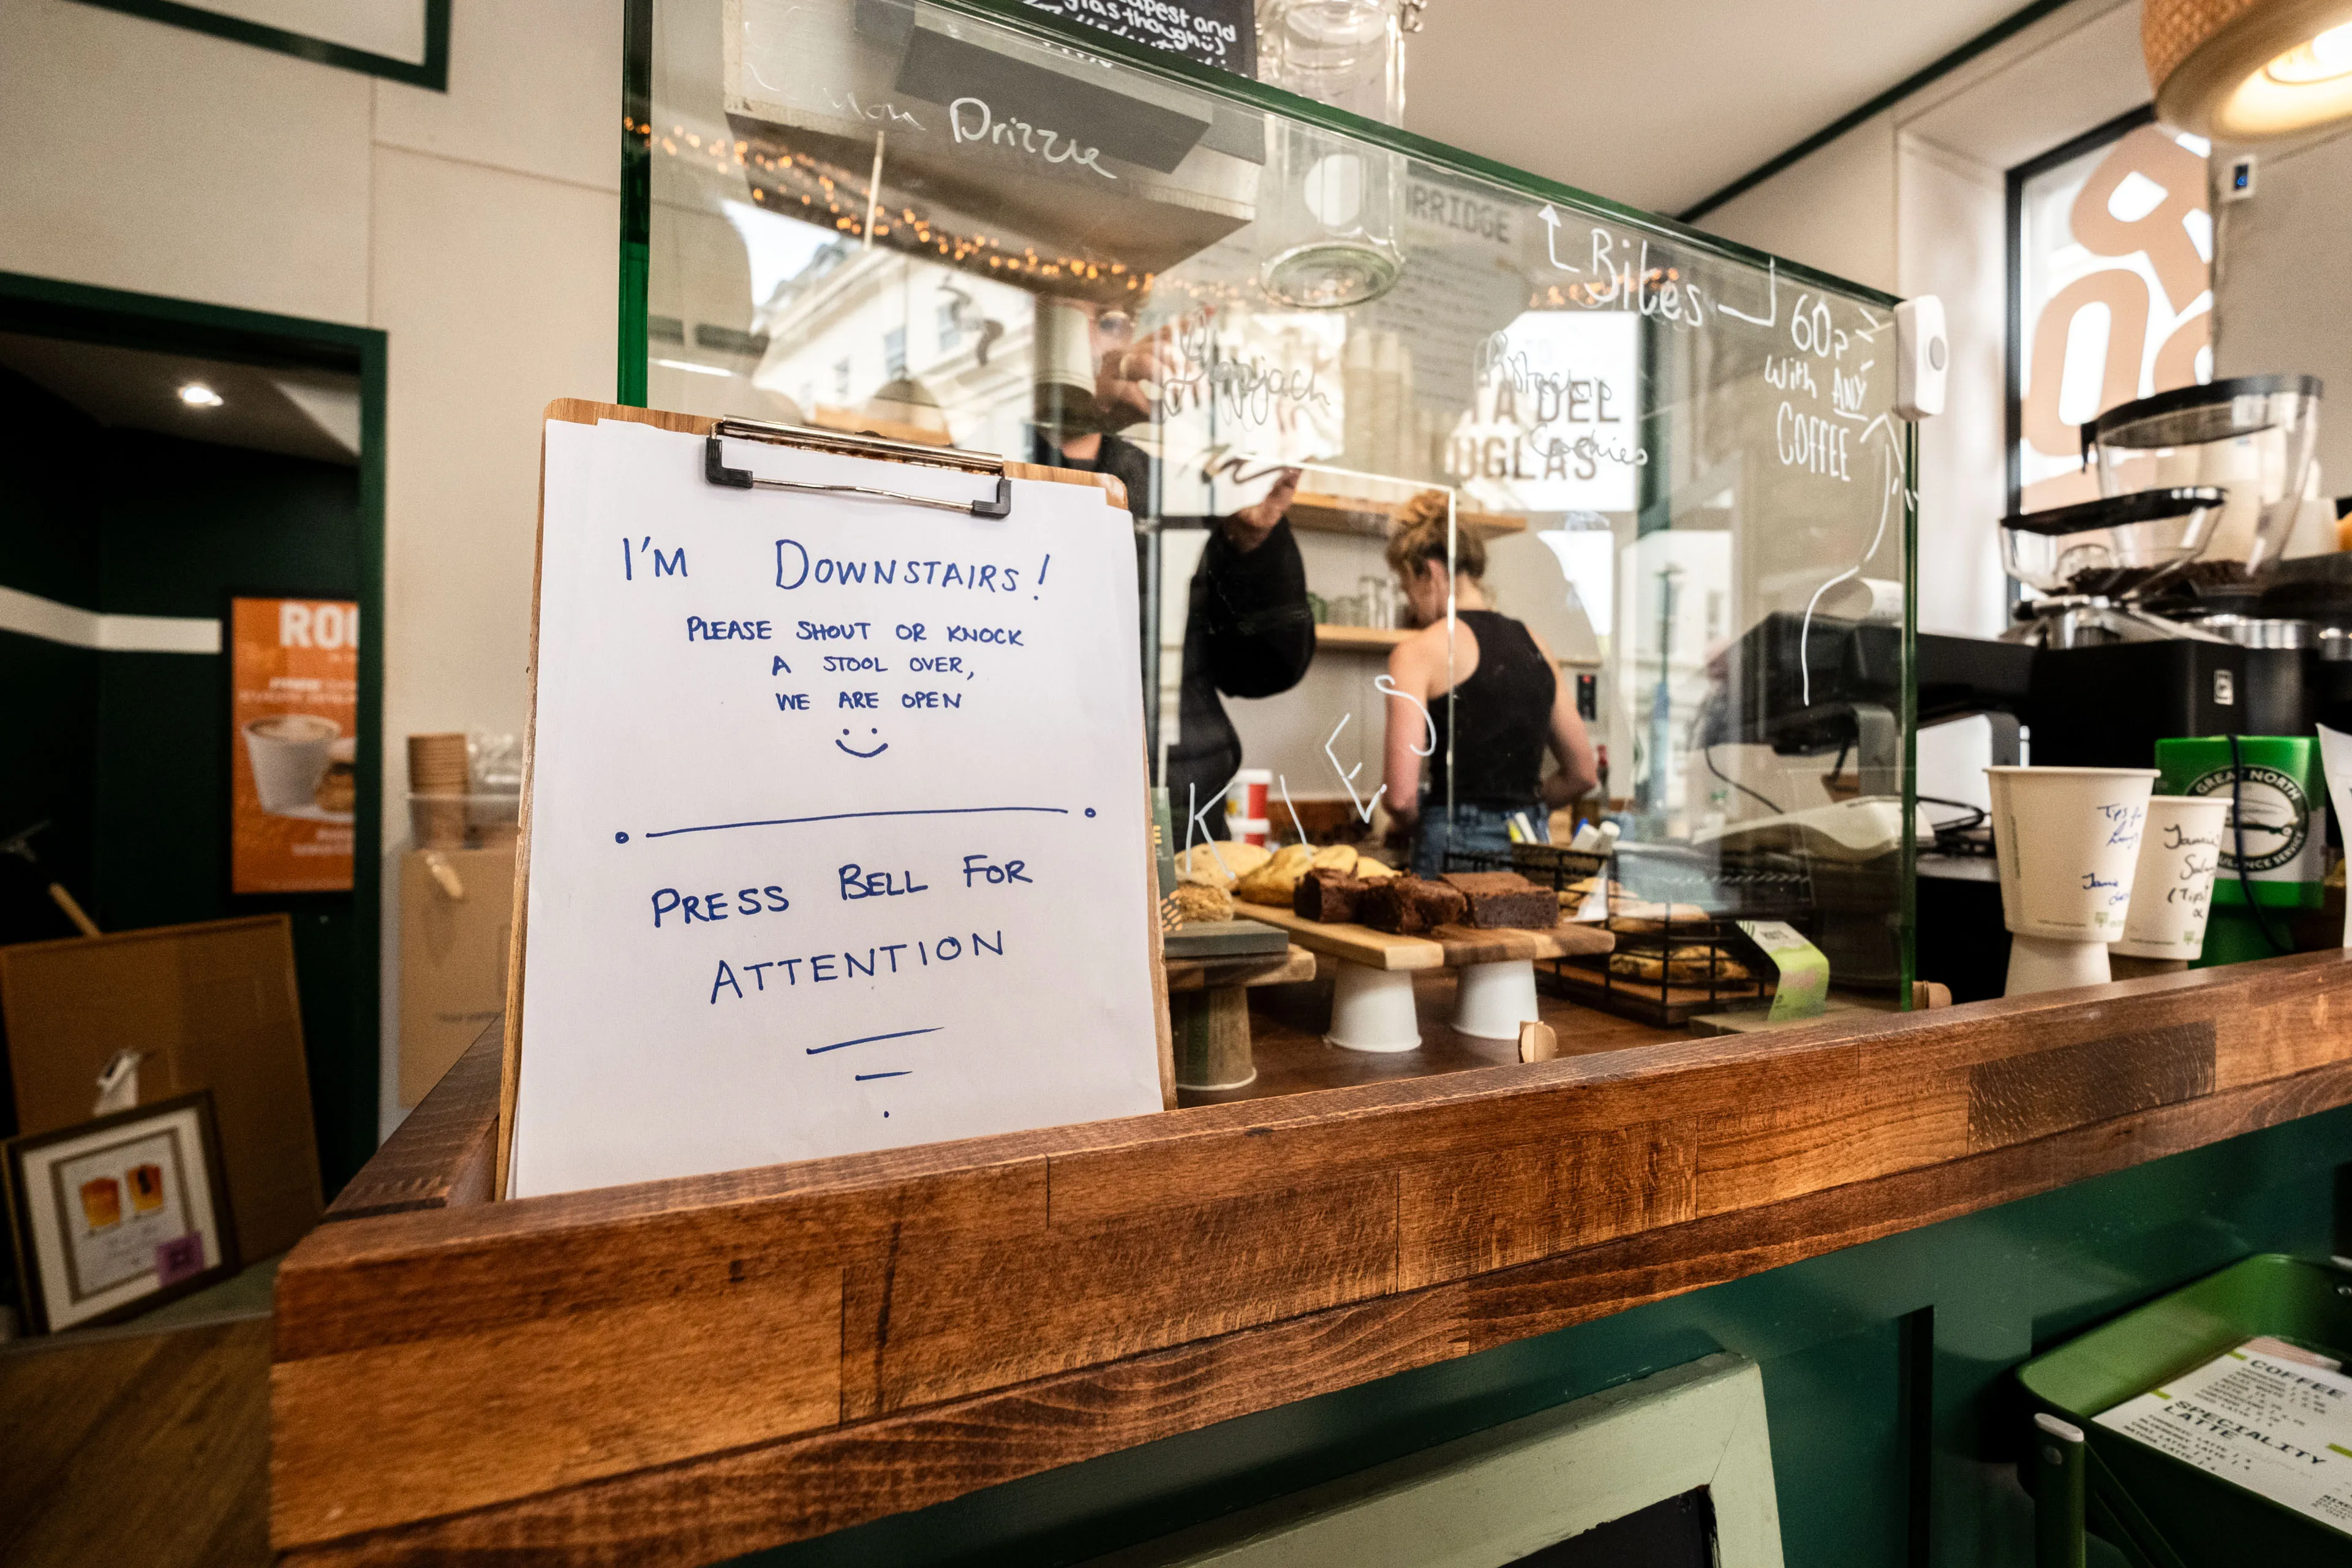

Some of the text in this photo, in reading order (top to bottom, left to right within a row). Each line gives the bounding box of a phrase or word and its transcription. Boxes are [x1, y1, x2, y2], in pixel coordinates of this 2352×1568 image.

[1121, 7, 1201, 51] though
[1193, 16, 1237, 42] and
[1584, 228, 1703, 327] Bites
[1790, 293, 1850, 360] 60p
[1764, 355, 1868, 411] with ANY
[1776, 401, 1851, 483] COFFEE
[624, 537, 687, 581] I'M
[687, 616, 1023, 646] PLEASE SHOUT OR KNOCK
[772, 656, 973, 679] A STOOL OVER,
[776, 692, 961, 710] WE ARE OPEN
[2195, 769, 2301, 801] GREA NORTH
[652, 855, 1032, 928] PRESS BELL FOR
[710, 930, 1003, 1005] ATTENTION
[2250, 1359, 2346, 1400] COFFEE
[2164, 1405, 2237, 1440] LATTE
[2174, 1400, 2327, 1464] SPECIALITY
